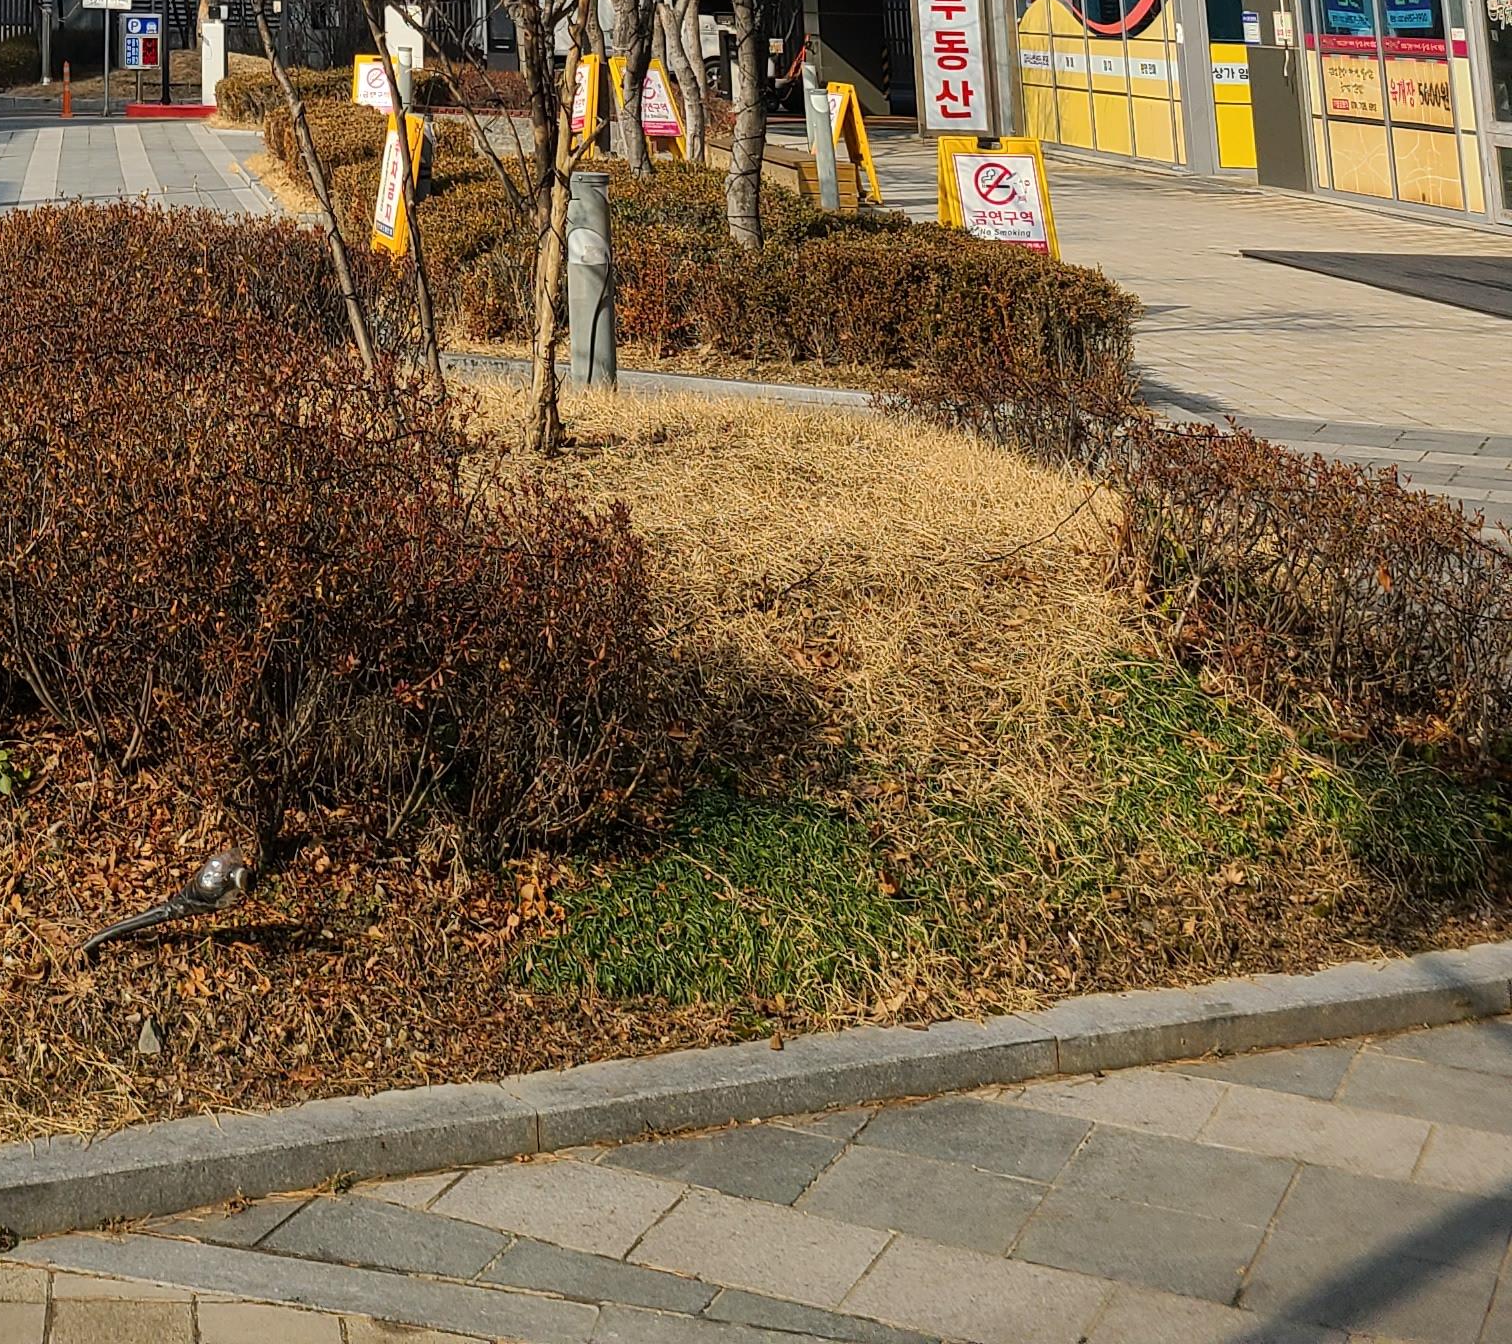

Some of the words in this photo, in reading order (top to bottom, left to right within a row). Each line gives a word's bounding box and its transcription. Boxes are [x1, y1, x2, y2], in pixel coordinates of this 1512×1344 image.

[1211, 67, 1236, 80] 상가
[1390, 78, 1415, 108] 육개장
[643, 102, 668, 113] 연구역
[972, 210, 1035, 226] 금연구역
[980, 228, 992, 236] No
[994, 228, 1031, 238] Smoking
